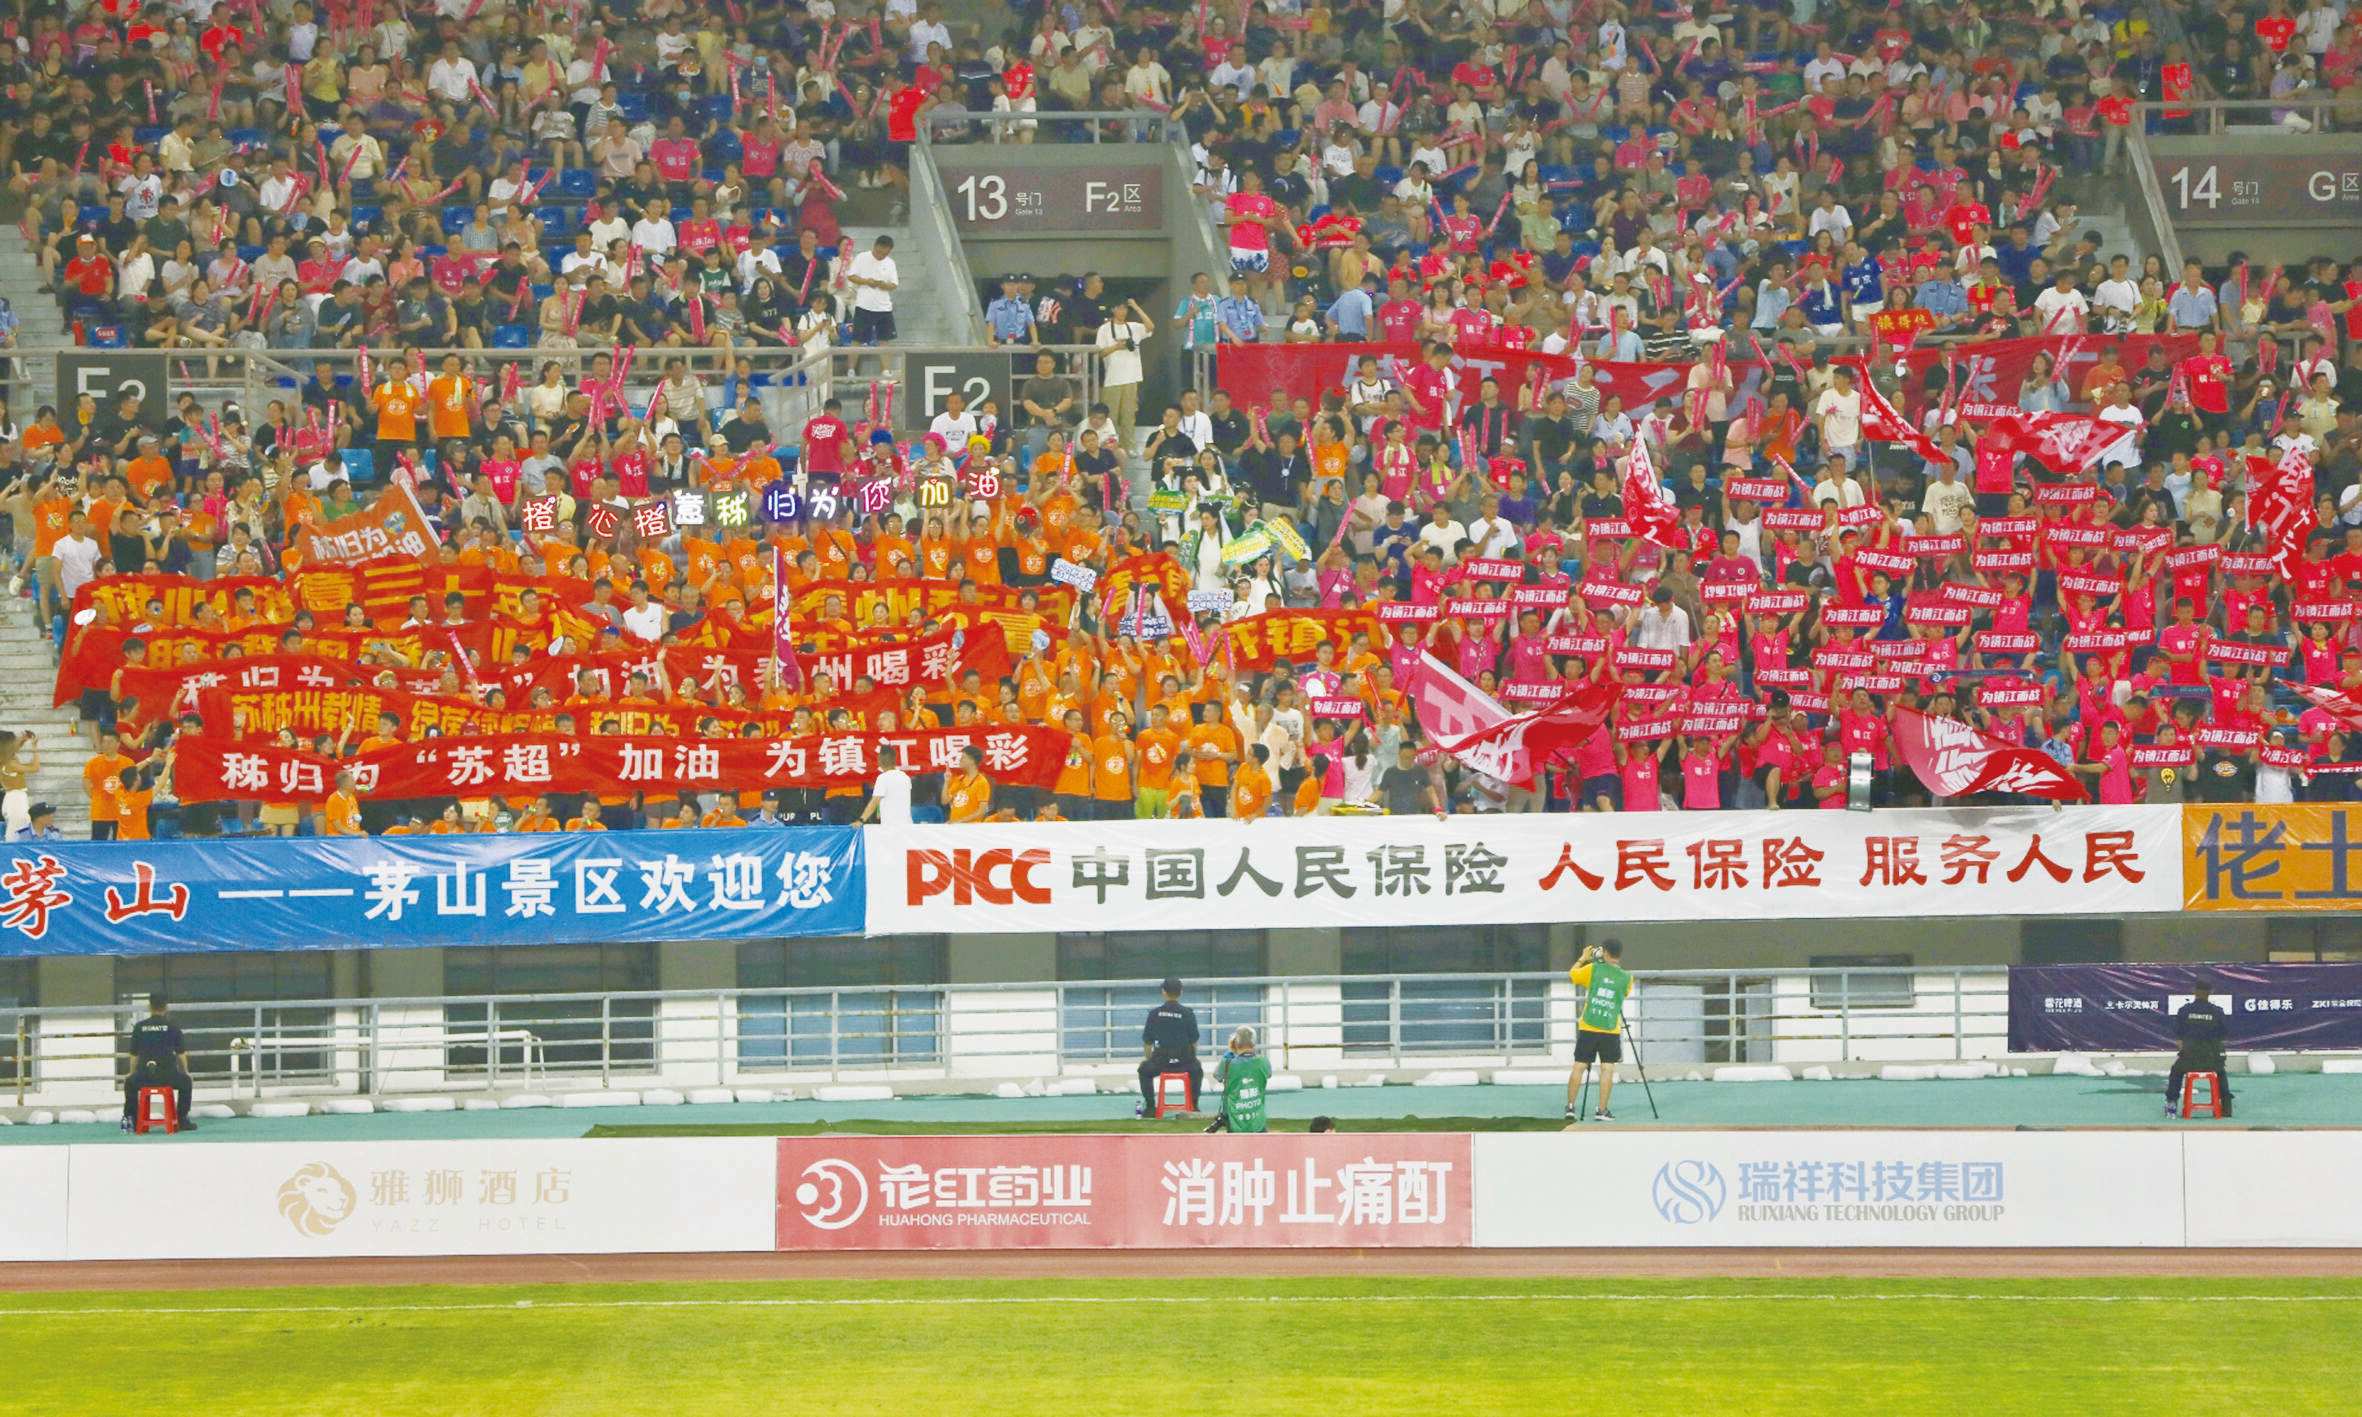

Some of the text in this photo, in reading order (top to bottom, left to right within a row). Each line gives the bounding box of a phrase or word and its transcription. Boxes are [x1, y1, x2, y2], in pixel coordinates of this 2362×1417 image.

[2171, 165, 2258, 209] 14 号门
[2308, 171, 2359, 202] G 区
[957, 175, 1042, 221] 13 号门
[1086, 182, 1141, 213] F2 区
[2232, 197, 2249, 205] Gate
[1015, 207, 1033, 216] Gate
[1123, 205, 1141, 213] Area
[924, 365, 991, 417] F2
[1730, 482, 1786, 498] 为镇江而战
[1766, 512, 1823, 526] 为镇江而战
[1981, 520, 2036, 533] 为镇江而战
[2048, 528, 2104, 543] 为镇江而战
[1908, 539, 1961, 551] 为镇江而战
[1856, 552, 1912, 569] 为镇江而战
[1976, 553, 2032, 566] 为镇江而战
[1467, 563, 1522, 577] 为镇江而战
[2061, 577, 2121, 592] 为镇江而战
[1515, 590, 1567, 602] 为镇江而战
[1583, 584, 1642, 601] 为镇江而战
[1944, 588, 2001, 604] 为镇江而战
[1381, 606, 1438, 618] 为镇江而战
[1450, 602, 1506, 614] 为镇江而战
[1826, 610, 1880, 623] 为镇江而战
[1909, 610, 1967, 622] 为镇江而战
[1548, 638, 1605, 651] 为镇江而战
[1980, 635, 2035, 648] 为镇江而战
[2068, 635, 2125, 647] 为镇江而战
[1616, 653, 1672, 666] 为镇江而战
[1816, 653, 1873, 667] 为镇江而战
[1842, 677, 1900, 688] 为镇江而战
[1506, 685, 1562, 698] 为镇江而战
[1981, 691, 2039, 703] 为镇江而战
[1692, 703, 1748, 714] 为镇江而战
[1619, 720, 1671, 738] 为镇江而战
[1682, 718, 1739, 731] 为镇江而战
[2200, 729, 2258, 744] 为镇江而战
[222, 732, 1027, 793] 秭归为 “苏超” 加油 为镇江喝彩
[2134, 750, 2191, 763] 为镇江而战
[907, 829, 2147, 905] PICC 中国人民保险 人民保险 服务人民
[0, 855, 190, 938] 茅山
[1591, 997, 1615, 1009] PHOTO
[369, 1167, 573, 1206] 雅狮酒店
[880, 1159, 1091, 1208] 花红药业
[1738, 1160, 2004, 1202] 瑞祥科技集团
[1161, 1157, 1452, 1227] 消肿止痛酊
[880, 1212, 1091, 1226] HUAHONG PHARMACEUTICAL
[1738, 1205, 2004, 1222] RUIXIANG TECHNOLOGY GROUP
[371, 1216, 566, 1232] YAZZ HOTEL
